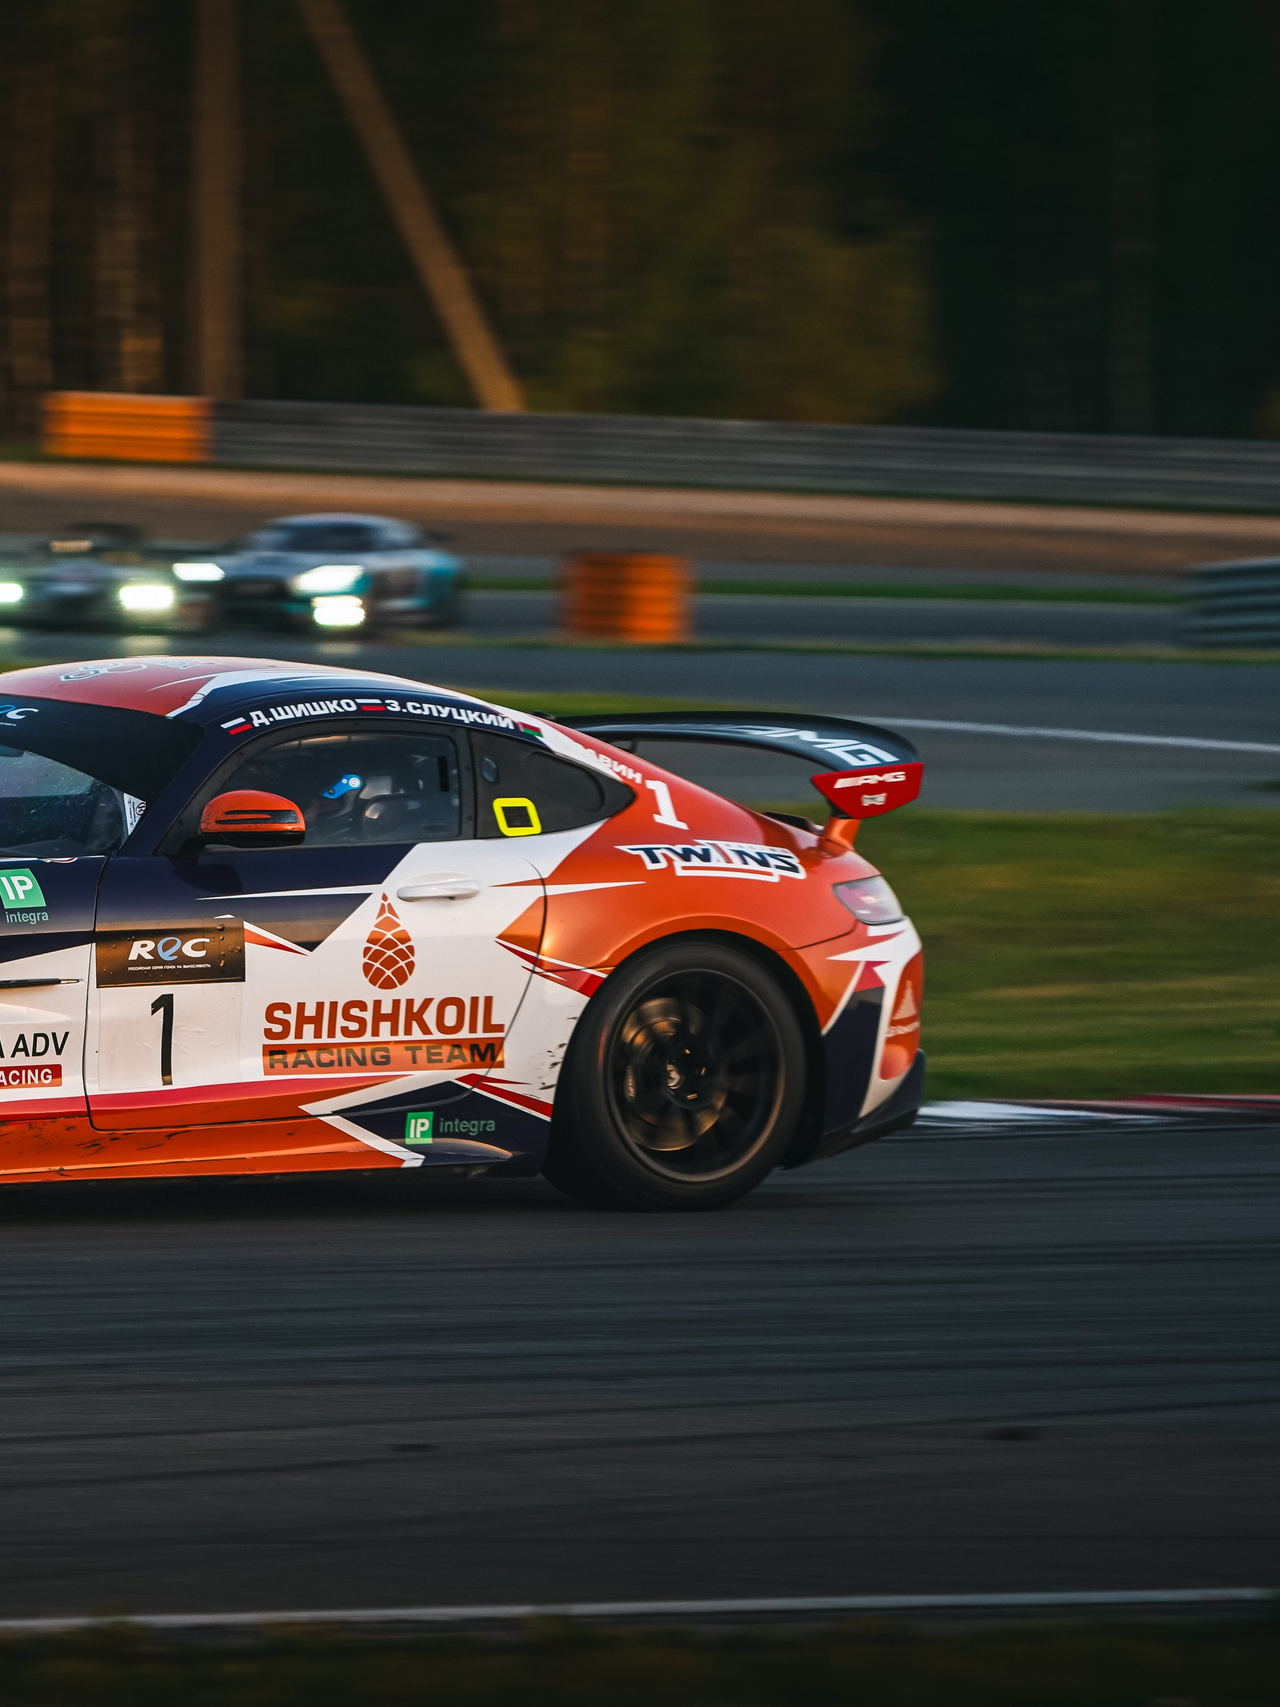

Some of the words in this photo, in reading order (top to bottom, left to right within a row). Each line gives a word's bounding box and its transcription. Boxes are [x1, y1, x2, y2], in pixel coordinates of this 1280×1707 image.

[251, 699, 357, 727] Д.ШИШКО
[646, 780, 689, 830] 1
[622, 842, 804, 876] TWINS
[0, 876, 33, 900] IP
[6, 911, 49, 925] integra
[264, 996, 505, 1040] SHISHKOIL
[11, 1032, 69, 1058] ADV
[151, 994, 174, 1086] 1
[269, 1047, 391, 1069] RACING
[405, 1043, 497, 1064] TEAM
[410, 1118, 430, 1138] IP
[439, 1118, 496, 1136] integra
